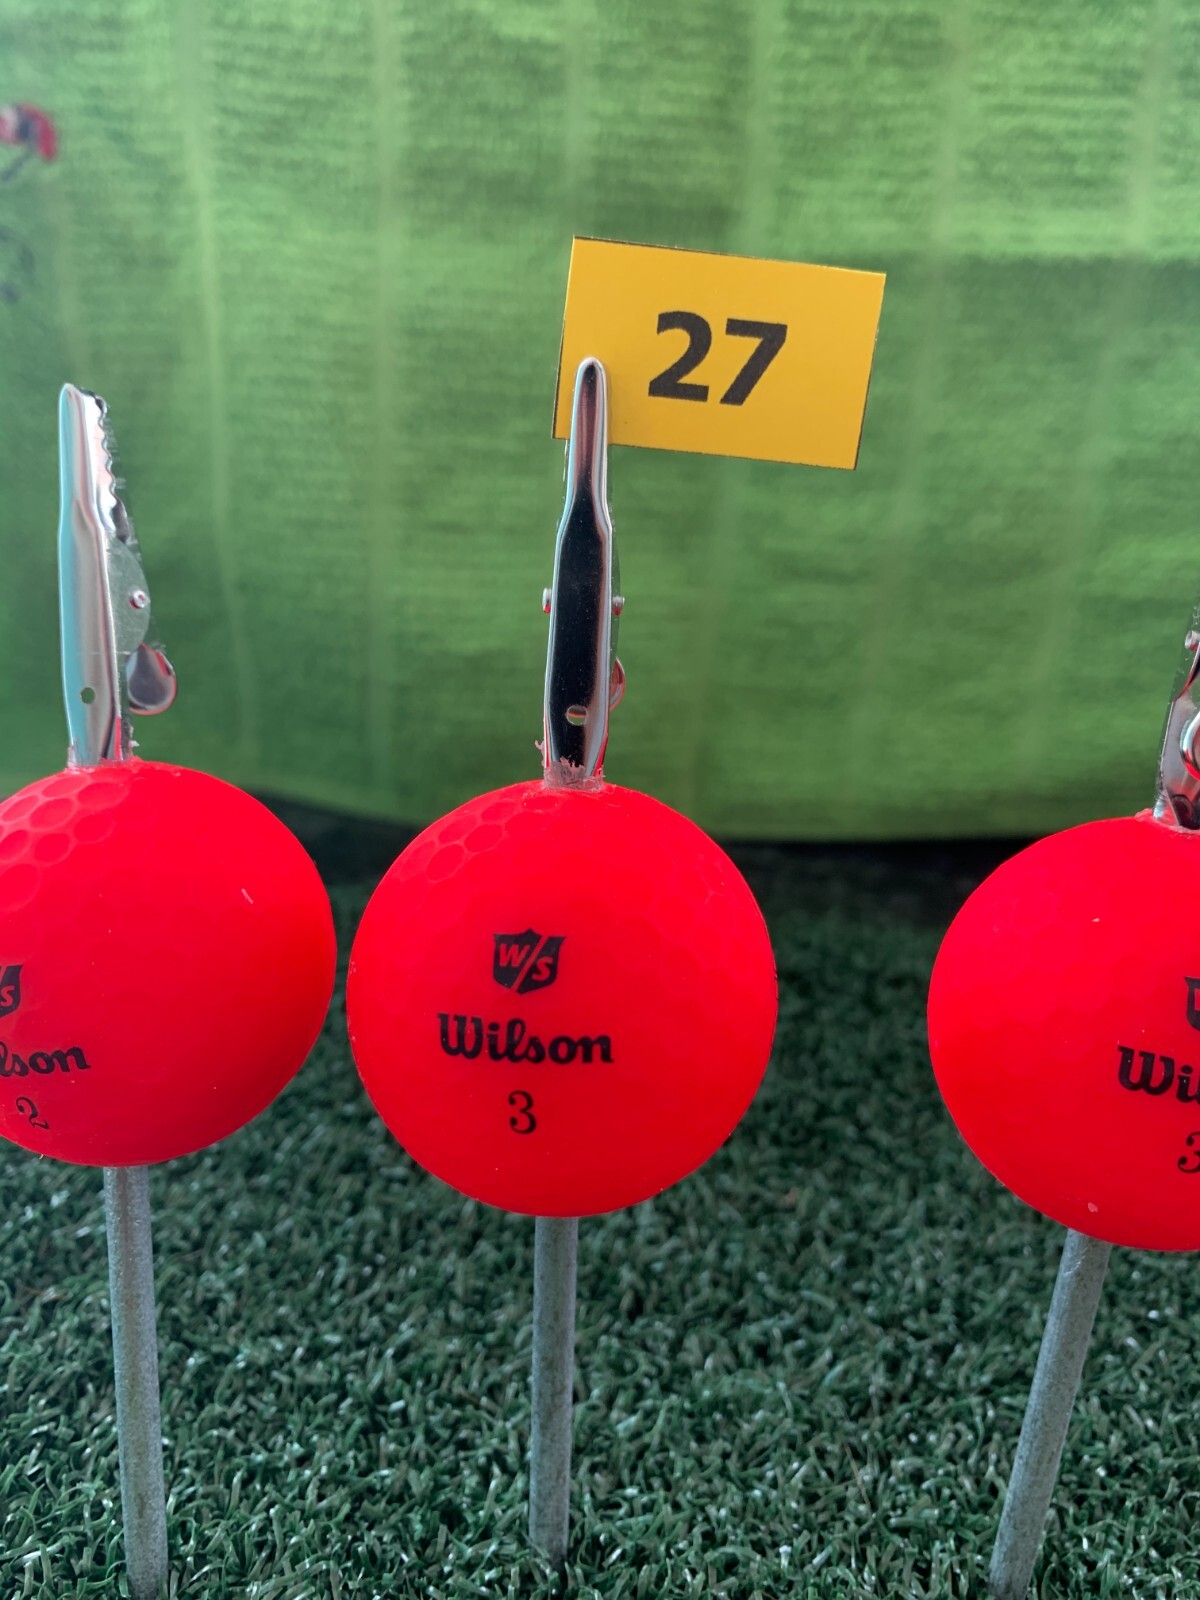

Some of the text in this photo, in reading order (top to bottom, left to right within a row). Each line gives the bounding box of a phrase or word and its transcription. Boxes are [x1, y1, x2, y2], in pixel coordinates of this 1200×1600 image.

[648, 310, 788, 406] 27
[437, 1012, 614, 1065] Wilson
[16, 1096, 50, 1130] 2
[508, 1090, 537, 1134] 3
